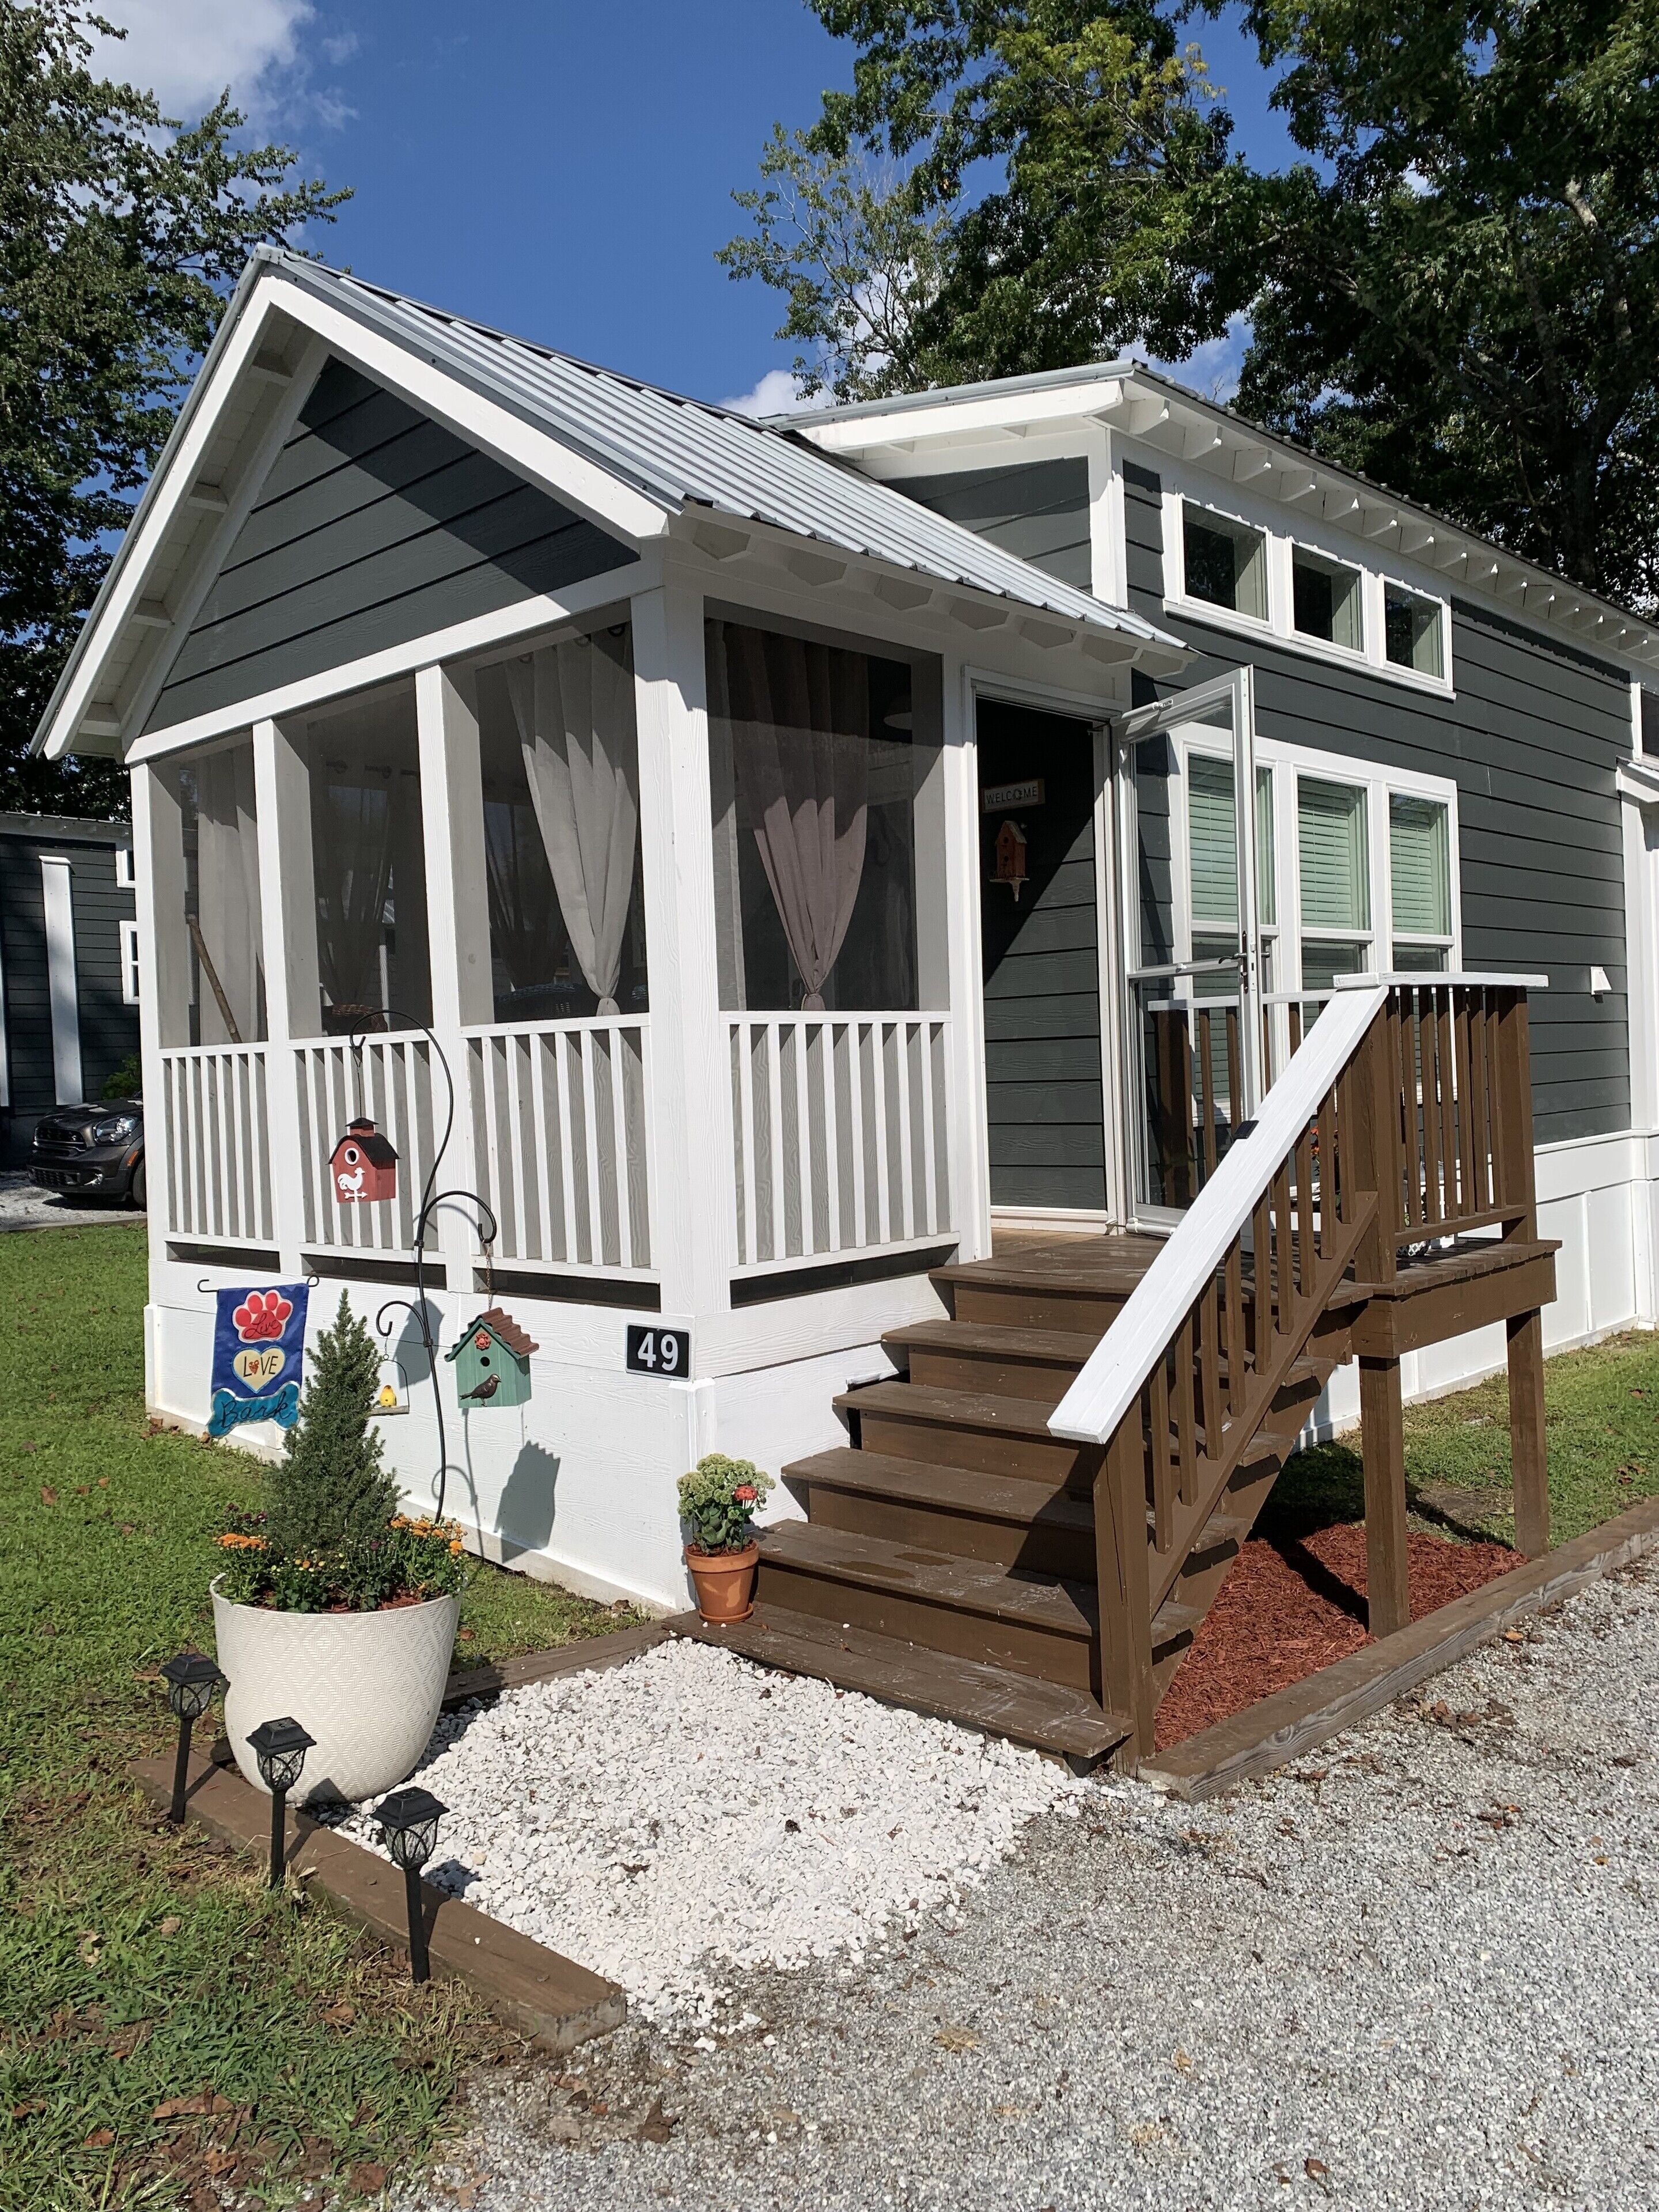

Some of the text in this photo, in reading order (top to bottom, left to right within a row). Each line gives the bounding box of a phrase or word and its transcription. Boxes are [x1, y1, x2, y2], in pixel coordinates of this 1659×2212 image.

[986, 786, 1037, 804] WELCOME
[244, 1313, 279, 1339] Live
[637, 1332, 679, 1371] 49
[221, 1391, 293, 1429] Bark
